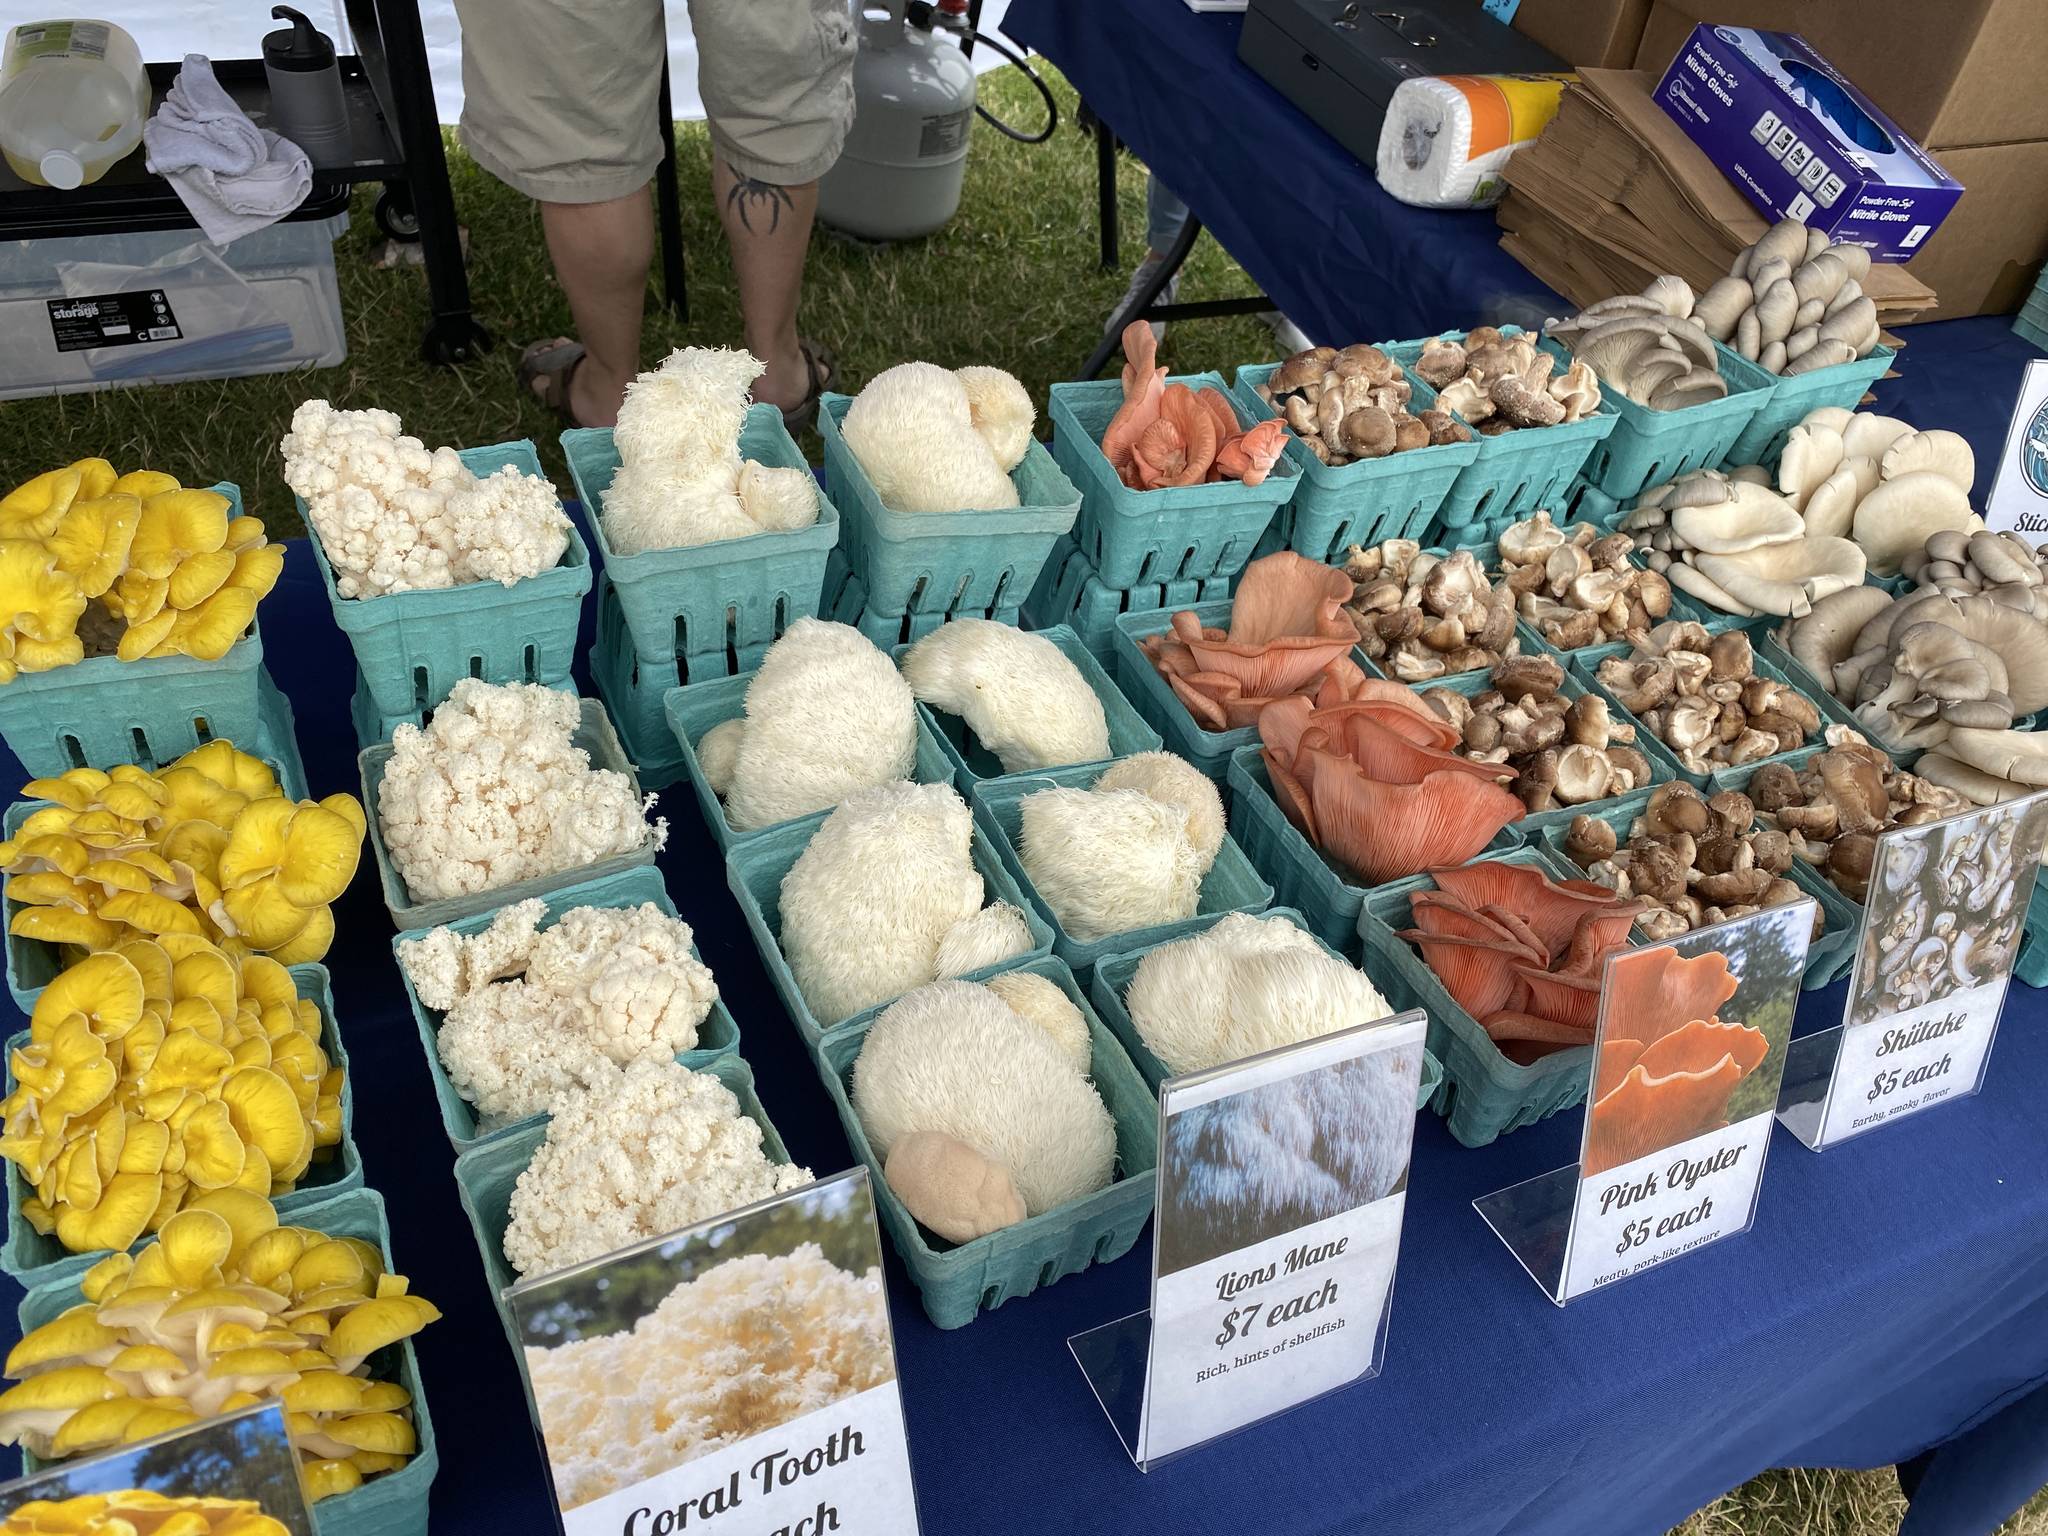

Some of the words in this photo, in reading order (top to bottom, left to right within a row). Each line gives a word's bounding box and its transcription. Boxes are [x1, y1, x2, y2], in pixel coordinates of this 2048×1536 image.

[1685, 54, 1708, 81] Nitrile
[1707, 77, 1733, 107] Gloves
[1693, 41, 1714, 65] Powder
[1712, 60, 1726, 77] Free
[1734, 163, 1748, 180] USDA
[1746, 177, 1773, 206] Compliance
[1859, 195, 1886, 207] Powder
[1884, 197, 1900, 207] Free
[1795, 203, 1804, 216] L
[1849, 209, 1880, 221] Nitrile
[1880, 210, 1911, 222] Gloves
[53, 307, 99, 319] storage
[2013, 511, 2048, 533] Stic
[1875, 1012, 1968, 1058] Shiitake
[1867, 1069, 1902, 1105] $5
[1902, 1053, 1952, 1089] each
[1851, 1111, 1887, 1129] Earthy,
[1888, 1099, 1919, 1116] smoky
[1922, 1087, 1951, 1104] flavor
[1600, 1171, 1660, 1216] Pink
[1666, 1144, 1748, 1191] Oyster
[1615, 1216, 1653, 1258] $5
[1655, 1196, 1714, 1239] each
[1215, 1262, 1276, 1303] Lions
[1283, 1236, 1349, 1276] Mane
[1592, 1267, 1632, 1287] Meaty,
[1633, 1247, 1681, 1273] pork-like
[1682, 1229, 1721, 1250] texture
[1215, 1302, 1264, 1350] $7
[1266, 1277, 1338, 1328] each
[1195, 1363, 1231, 1383] Rich,
[1233, 1348, 1270, 1369] hints
[1271, 1339, 1289, 1355] of
[1289, 1318, 1346, 1348] shellfish
[623, 1470, 742, 1536] Coral
[750, 1424, 866, 1496] Tooth
